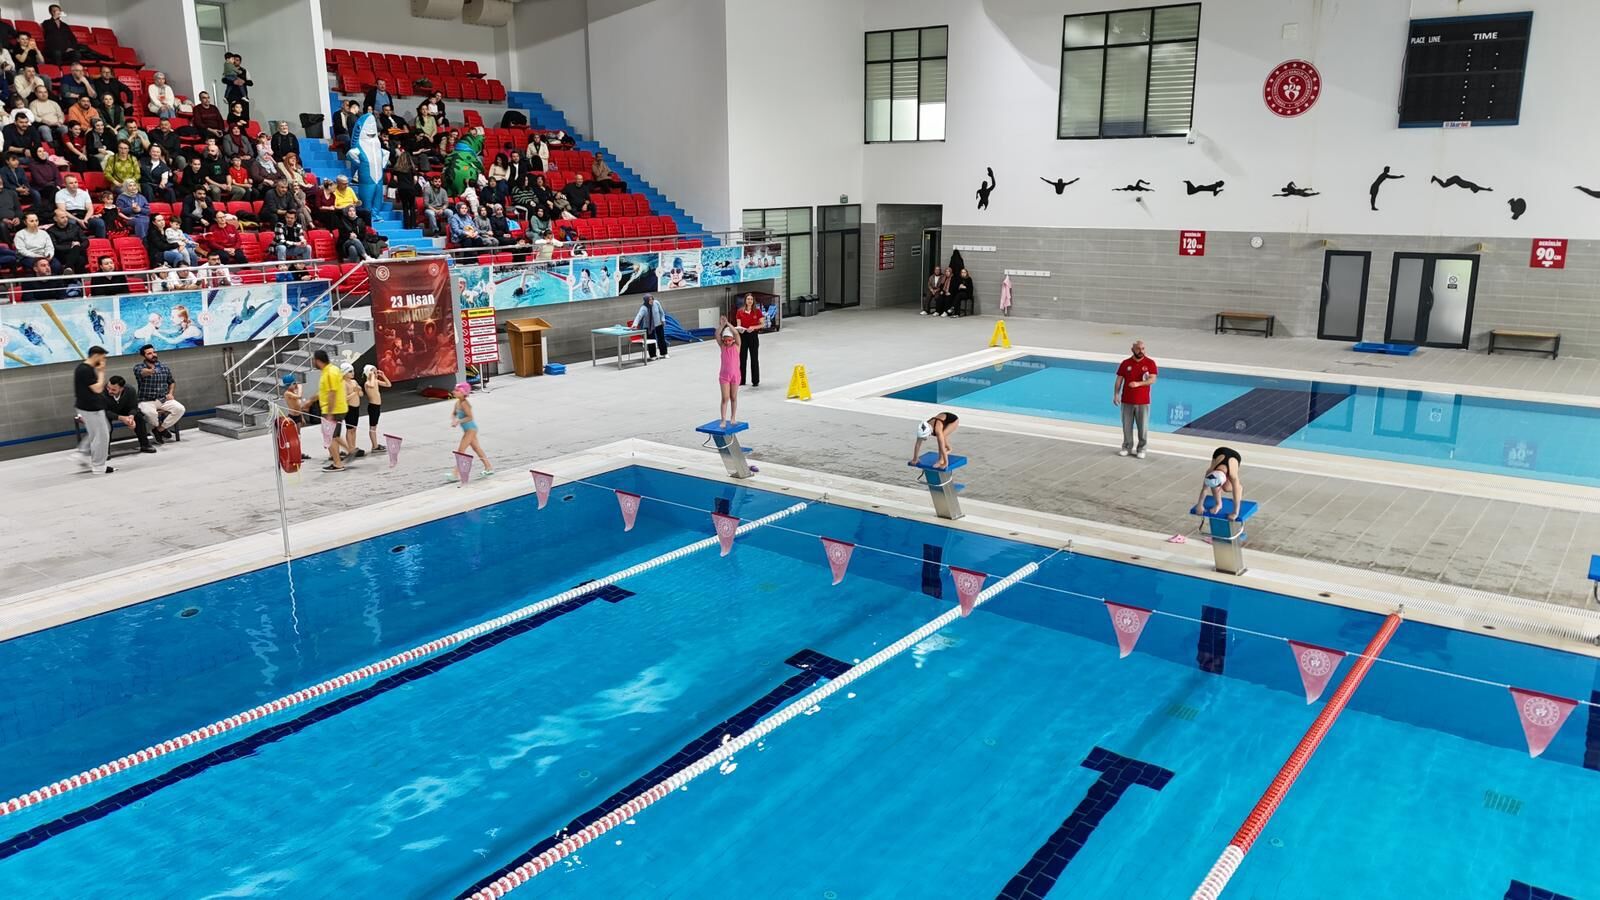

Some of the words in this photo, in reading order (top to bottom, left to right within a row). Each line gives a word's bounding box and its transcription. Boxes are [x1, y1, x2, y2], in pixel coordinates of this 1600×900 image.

[1473, 32, 1498, 40] TIME
[1183, 238, 1197, 249] 120
[1536, 247, 1554, 260] 90
[390, 295, 403, 308] 23
[406, 294, 435, 306] Nisan
